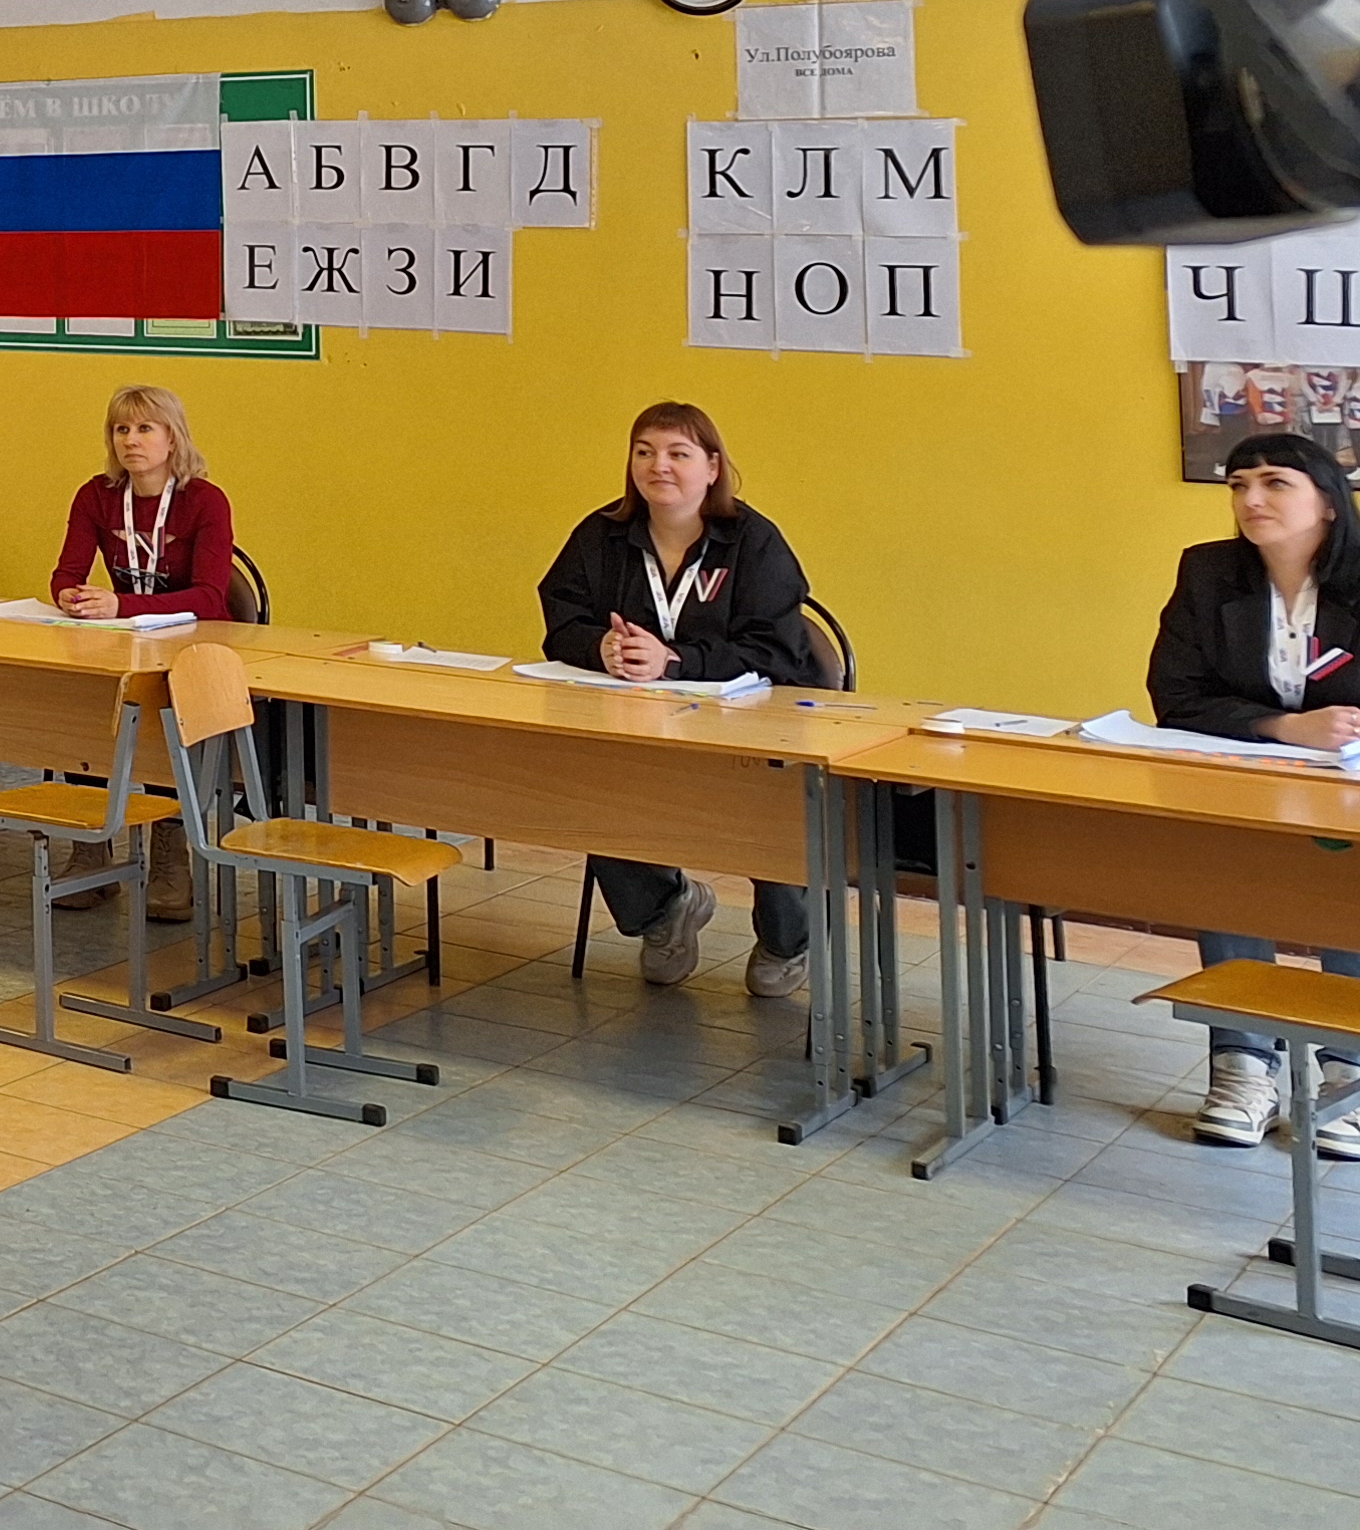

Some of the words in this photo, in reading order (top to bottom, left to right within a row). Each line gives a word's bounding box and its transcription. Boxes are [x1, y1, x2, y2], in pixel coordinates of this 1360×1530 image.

[795, 68, 817, 77] ВСЕ
[820, 67, 854, 77] ДОМА
[45, 96, 62, 118] В
[237, 144, 282, 191] А
[309, 144, 345, 191] Б
[378, 144, 420, 191] В
[455, 144, 496, 192] Г
[529, 144, 578, 206] Д
[700, 147, 754, 199] К
[786, 146, 841, 199] Л
[875, 147, 952, 200] М
[242, 244, 279, 291] Е
[301, 246, 360, 294] Ж
[386, 247, 418, 296] З
[446, 249, 497, 298] И
[705, 269, 762, 322] Н
[794, 262, 849, 316] О
[878, 264, 942, 318] П
[1182, 265, 1246, 322] Ч
